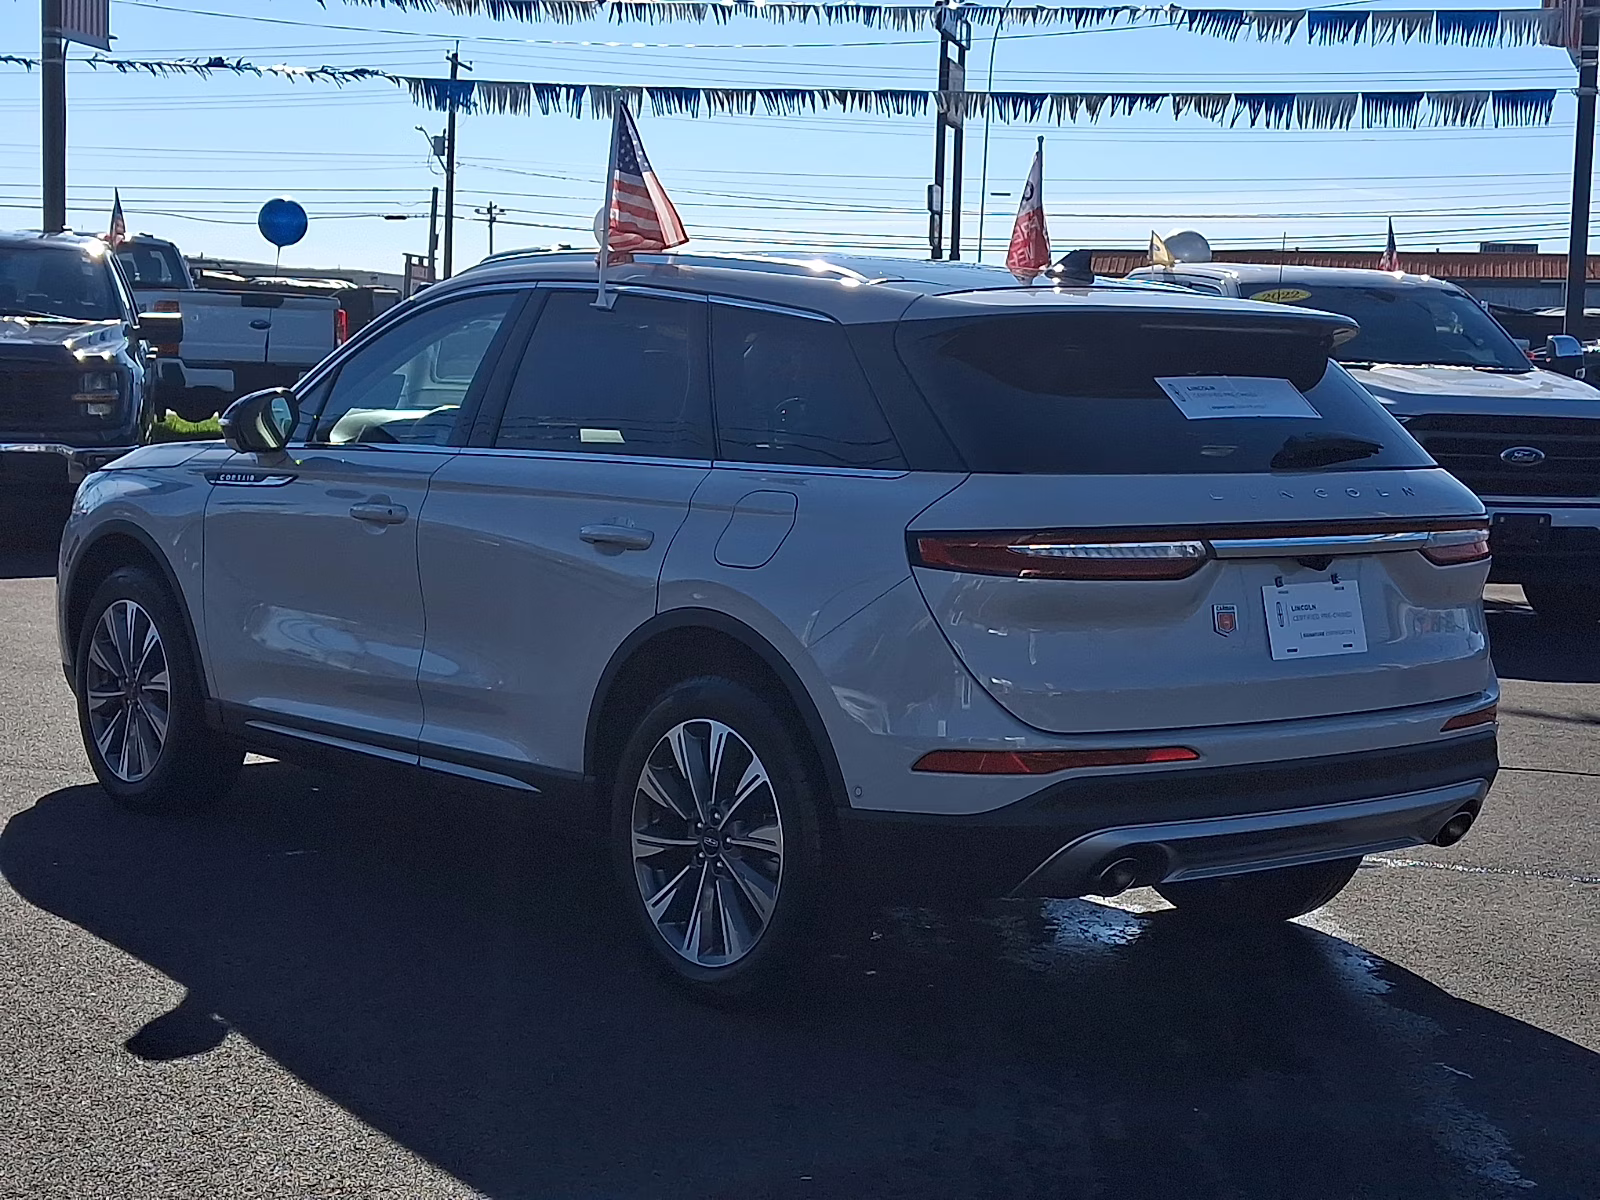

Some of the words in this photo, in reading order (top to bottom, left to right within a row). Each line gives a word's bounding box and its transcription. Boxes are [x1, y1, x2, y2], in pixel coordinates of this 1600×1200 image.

[1262, 291, 1300, 301] 2022
[1290, 604, 1317, 612] LINCOLN
[1292, 613, 1320, 622] CERTIFIED
